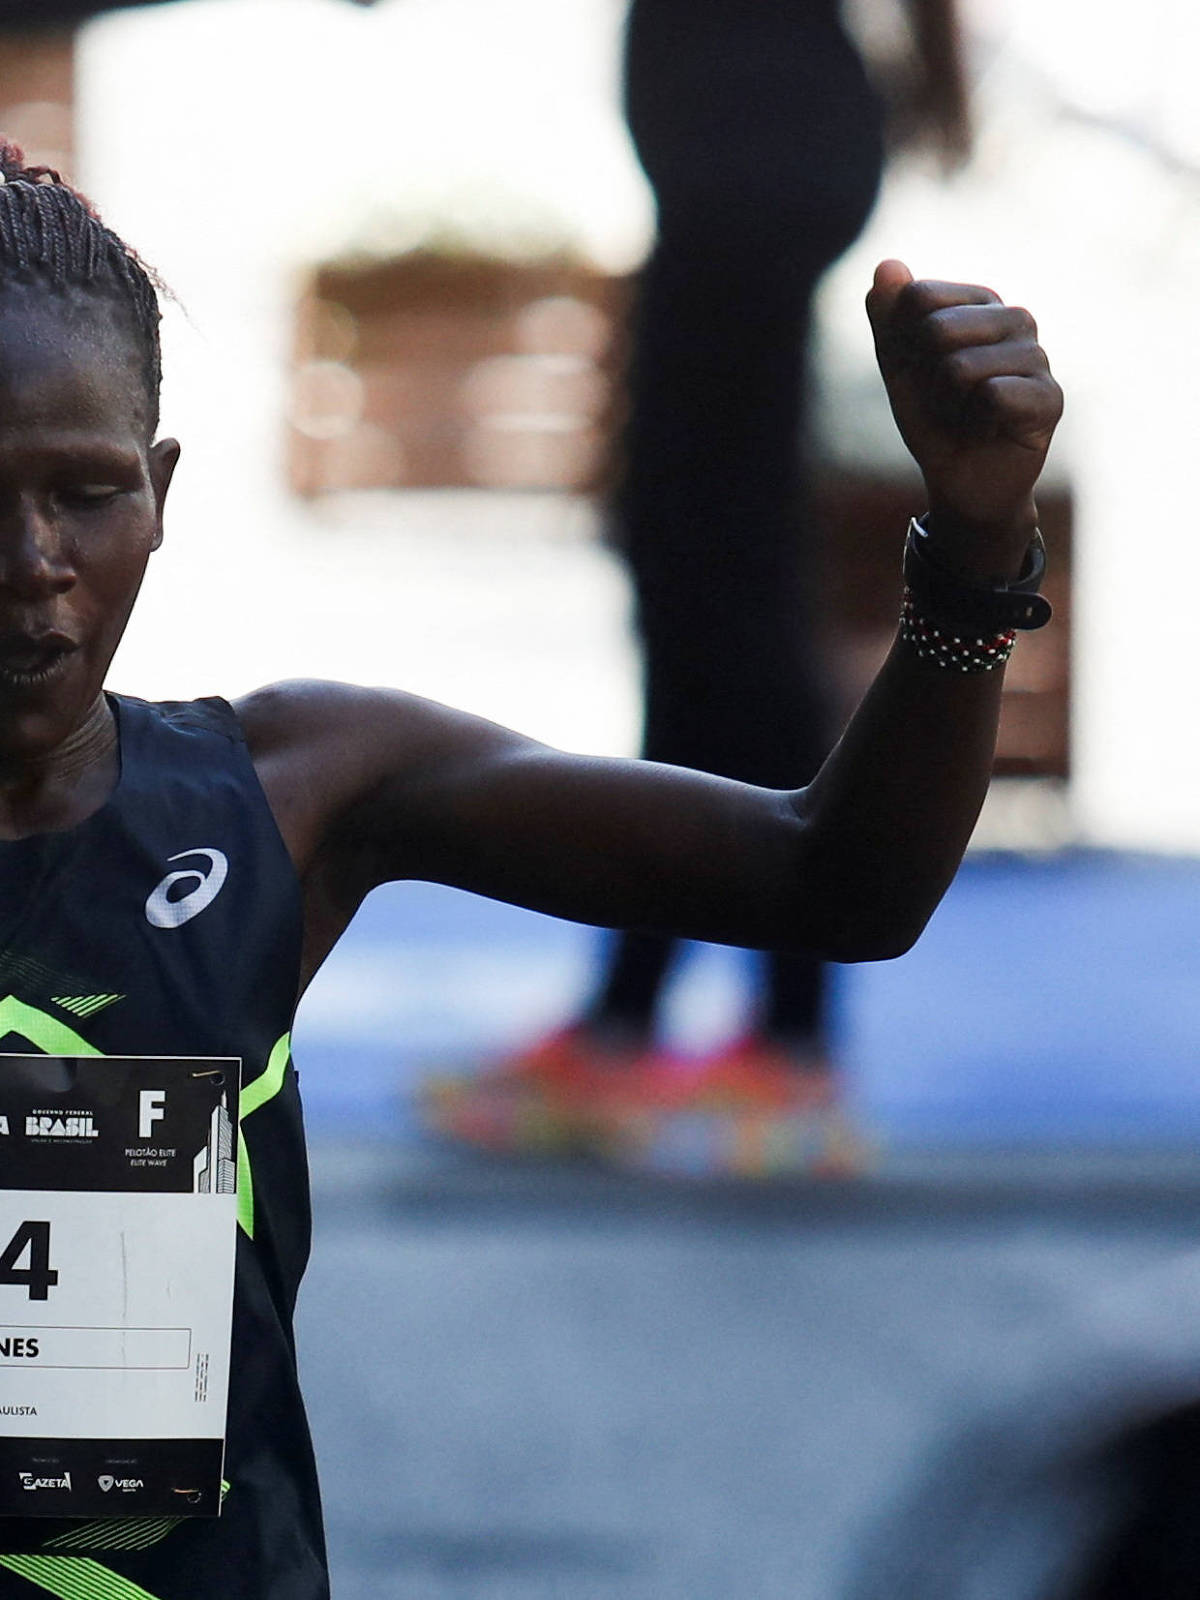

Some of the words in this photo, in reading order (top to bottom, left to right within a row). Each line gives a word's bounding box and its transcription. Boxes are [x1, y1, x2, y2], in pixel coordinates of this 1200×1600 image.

[139, 1090, 166, 1138] F
[25, 1116, 99, 1137] BRASIL
[125, 1147, 158, 1157] PELOTÃO
[159, 1148, 176, 1157] ELITE
[130, 1159, 146, 1167] ELITE
[147, 1159, 168, 1167] WAVE
[19, 1471, 73, 1492] GAZETA
[115, 1478, 144, 1488] VEGA
